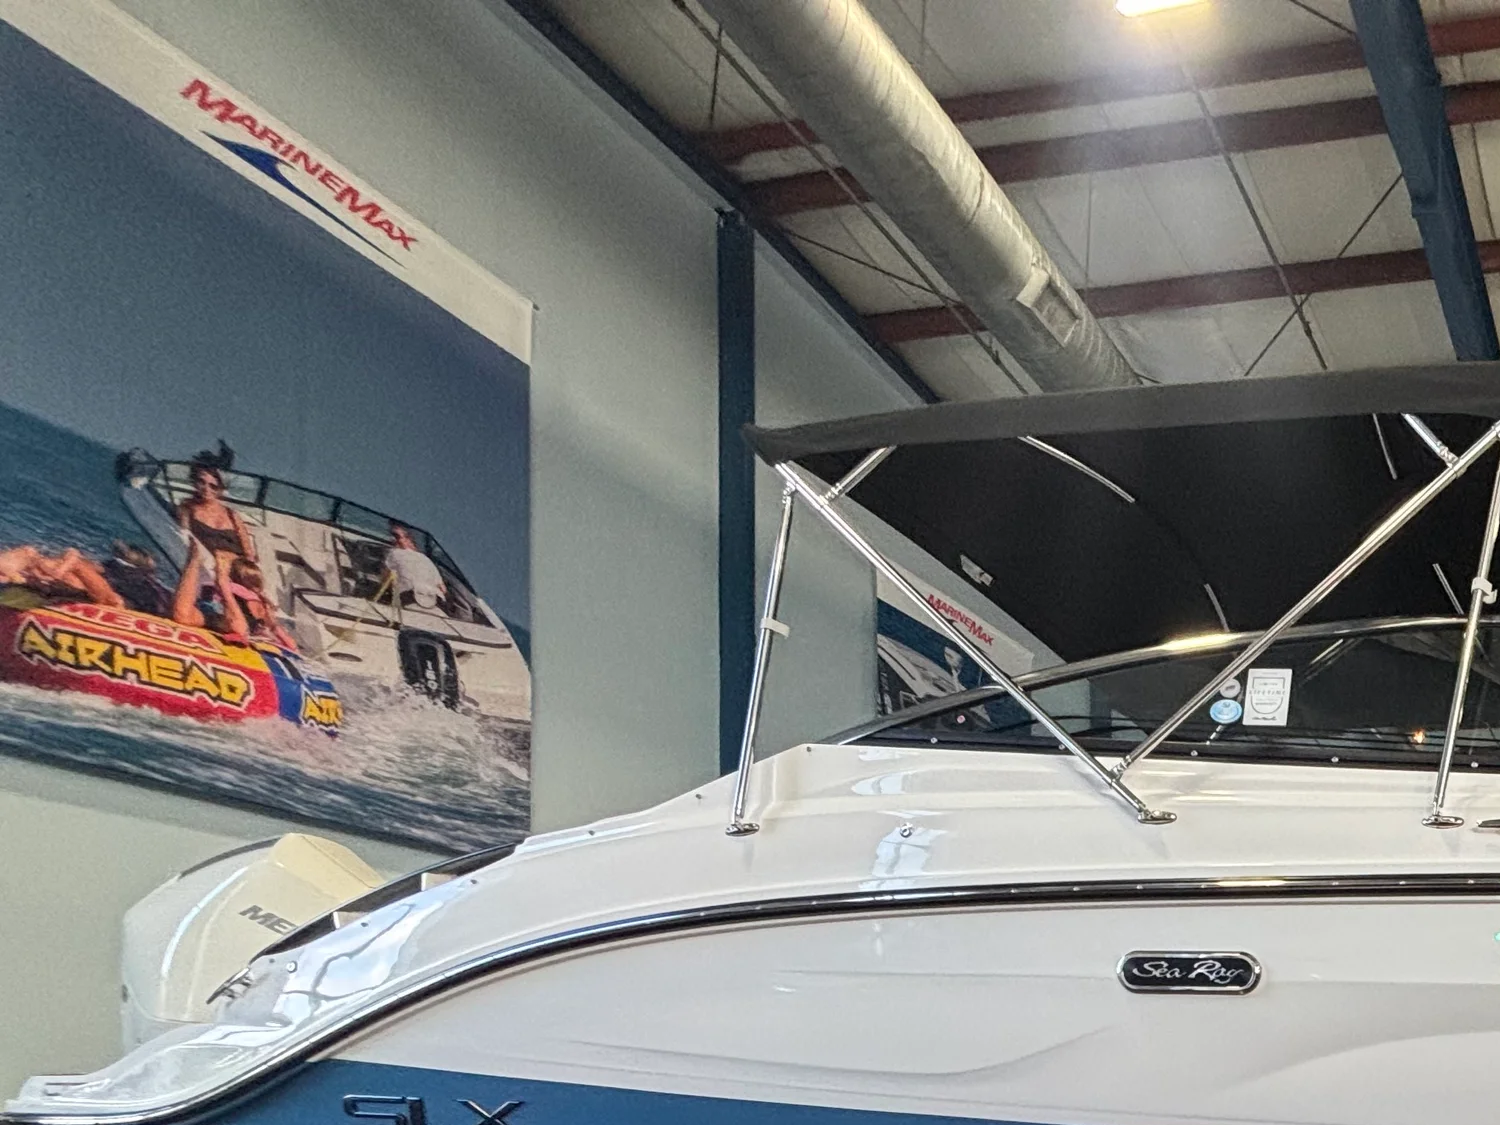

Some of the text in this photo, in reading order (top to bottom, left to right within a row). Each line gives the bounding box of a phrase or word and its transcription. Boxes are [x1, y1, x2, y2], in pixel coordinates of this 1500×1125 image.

[180, 78, 418, 251] MARINEMAX
[926, 594, 994, 646] MARINEMAX
[18, 617, 253, 707] AIRHEAD
[238, 904, 299, 936] ME
[1132, 960, 1244, 984] Sea Ray
